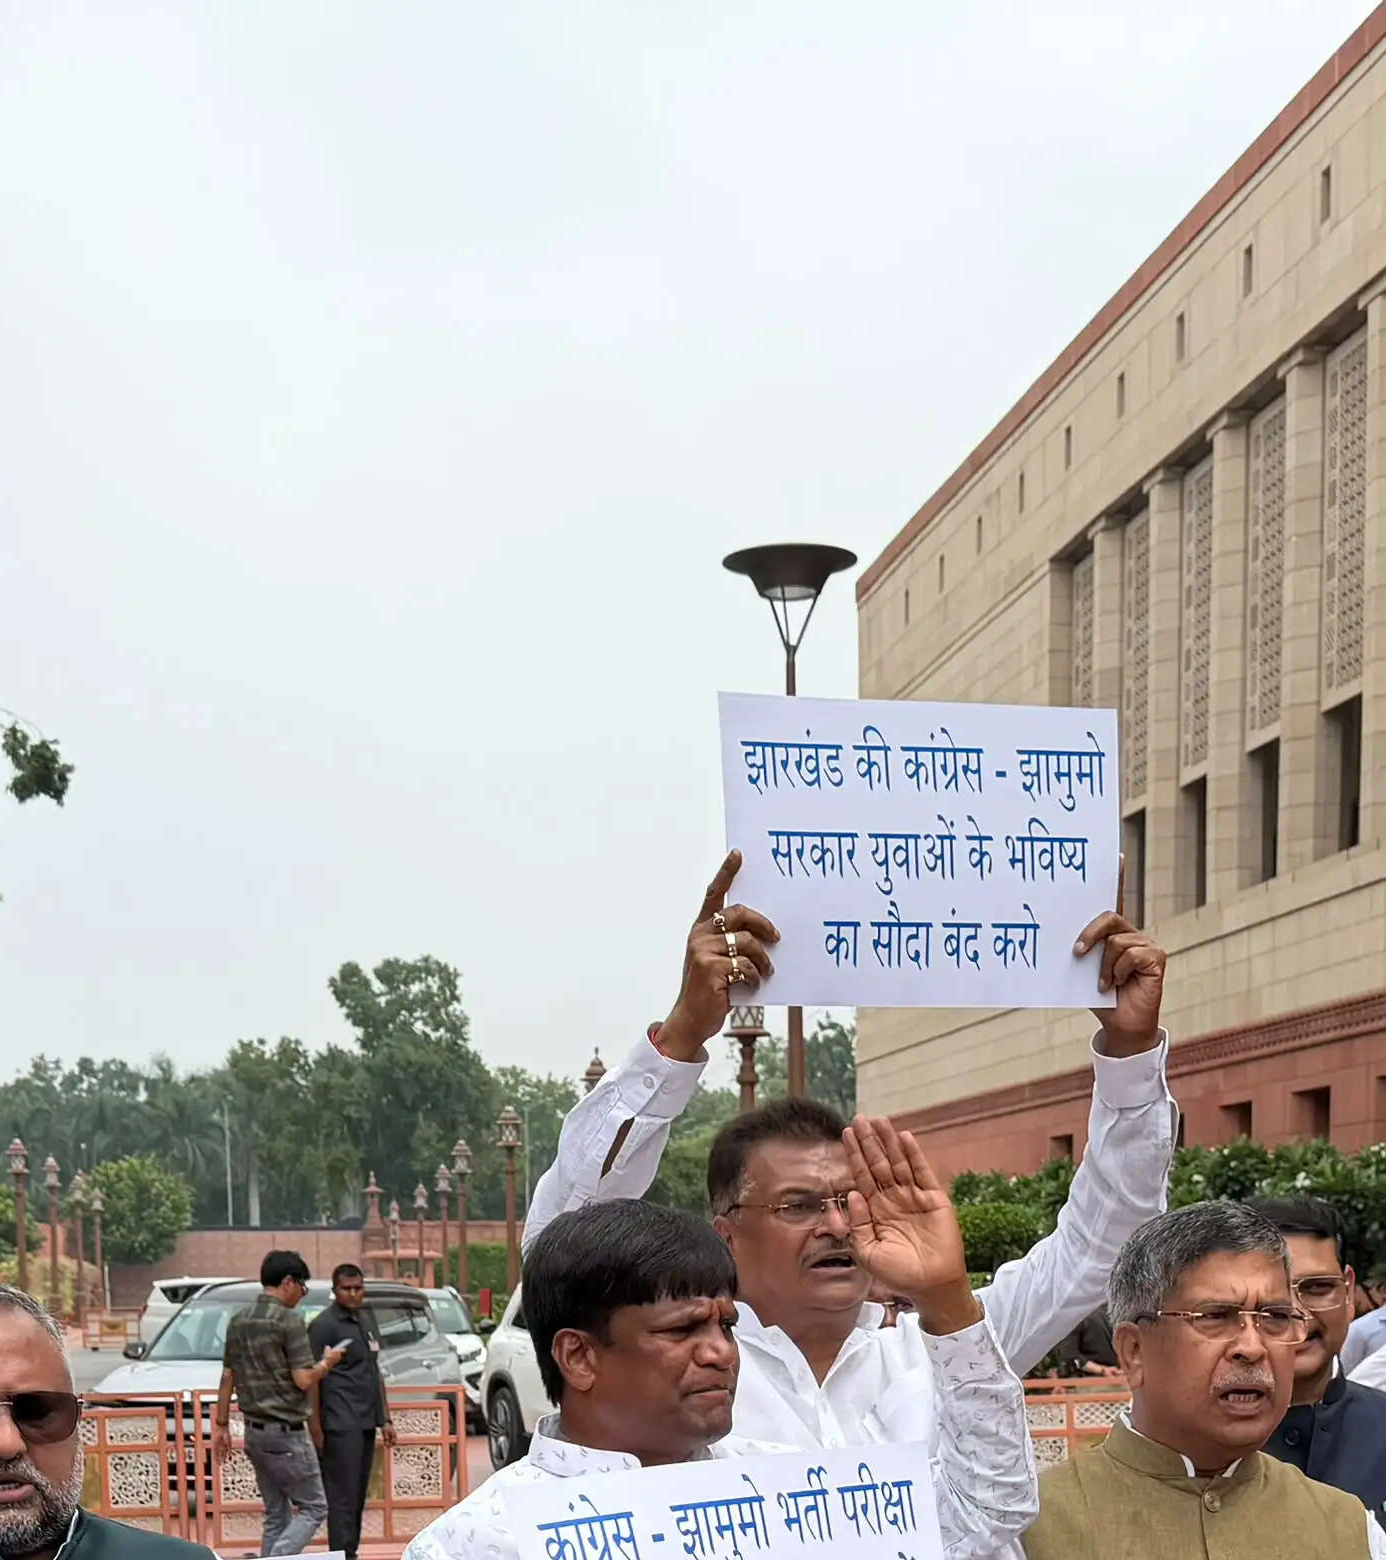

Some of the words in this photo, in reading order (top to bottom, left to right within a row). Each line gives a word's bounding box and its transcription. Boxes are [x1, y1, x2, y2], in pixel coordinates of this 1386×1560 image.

[741, 729, 843, 795] झारखंड
[852, 725, 892, 791] की
[900, 727, 984, 793] कांग्रेस
[995, 770, 1007, 778] -
[1016, 731, 1105, 812] झामुमो
[767, 830, 860, 878] सरकार
[867, 814, 957, 896] युवाओं
[965, 815, 994, 880] के
[1005, 817, 1088, 883] भविष्य
[823, 921, 861, 968] का
[870, 900, 933, 971] सौदा
[942, 908, 982, 971] बंद
[991, 904, 1040, 970] करो
[651, 1533, 665, 1542] -
[777, 1465, 832, 1544] भर्ती
[836, 1462, 916, 1537] परीक्षा
